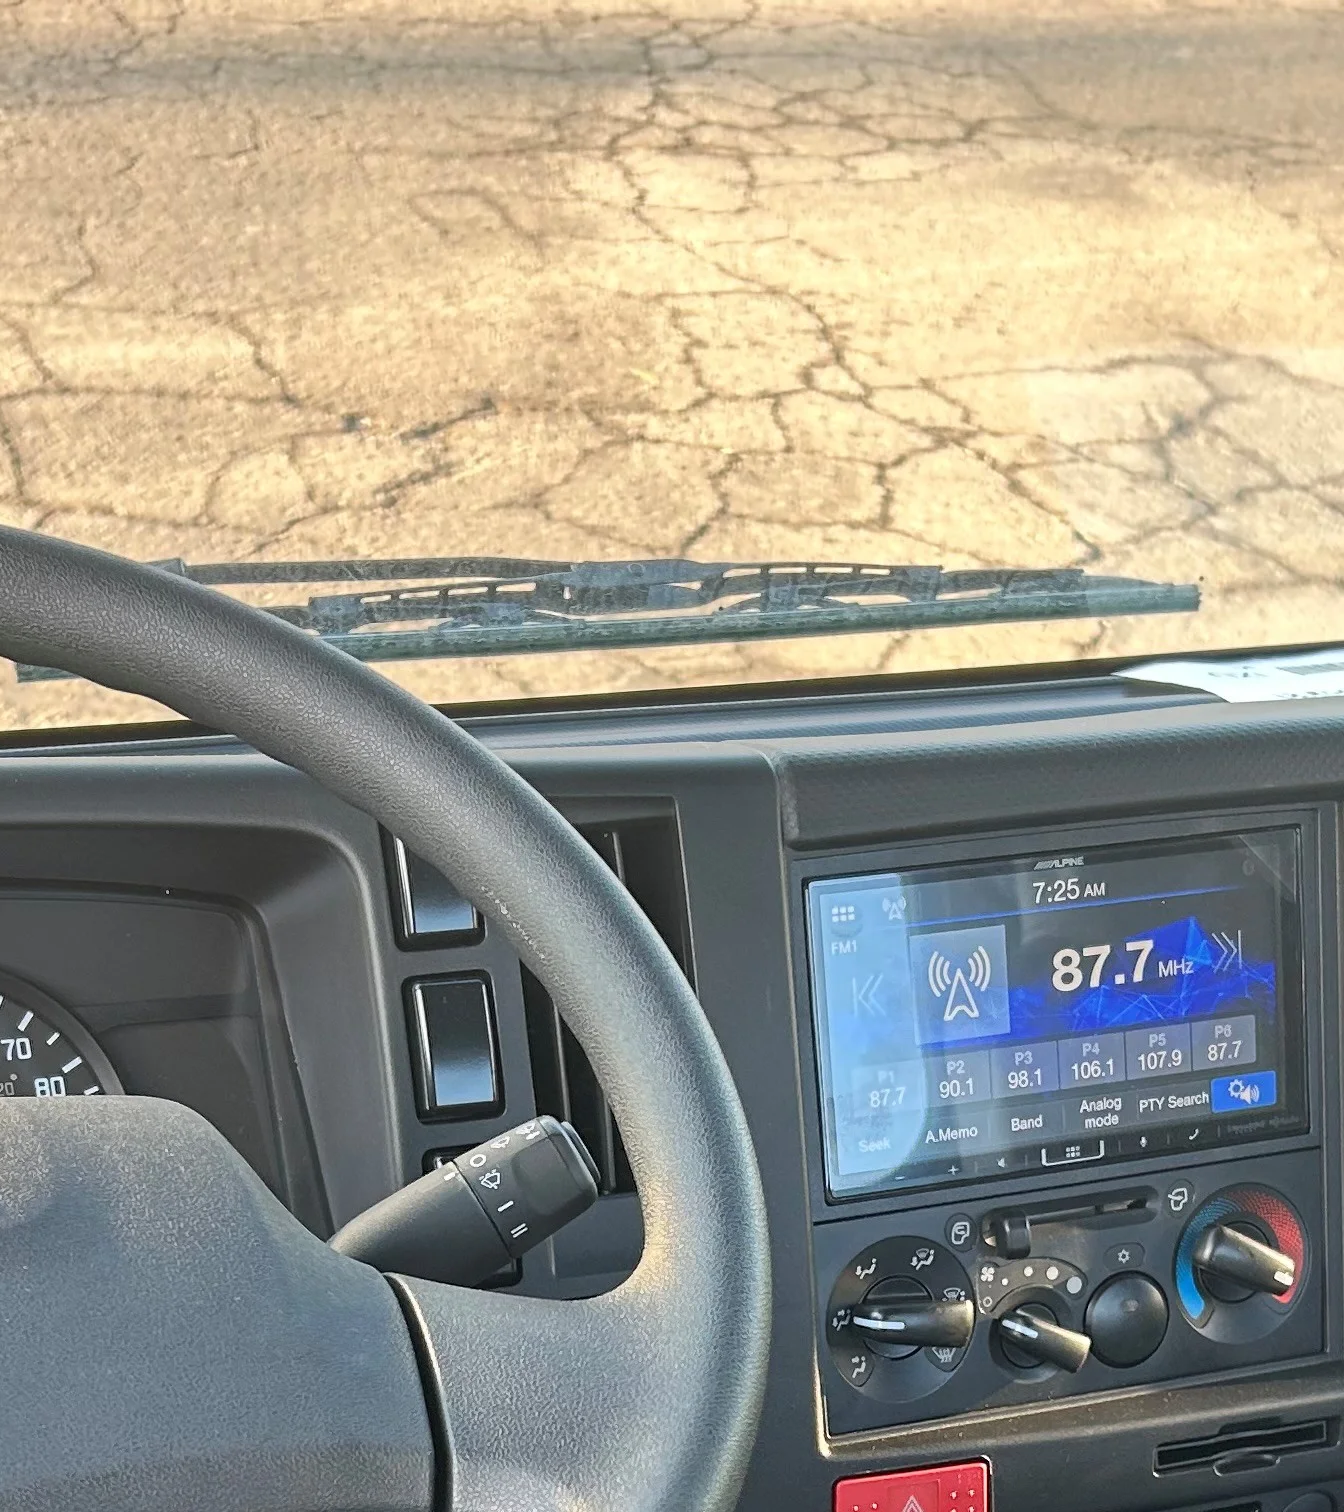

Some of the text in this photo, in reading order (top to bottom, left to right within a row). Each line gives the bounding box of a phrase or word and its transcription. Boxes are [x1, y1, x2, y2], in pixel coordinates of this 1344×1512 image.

[1033, 878, 1105, 904] 7:25 AM
[831, 941, 858, 955] FM1
[1052, 939, 1194, 992] 87.7 MHz
[1149, 1033, 1166, 1048] P5
[1214, 1024, 1232, 1039] P6
[0, 1037, 32, 1061] 70
[1015, 1051, 1033, 1066] P3
[1082, 1043, 1100, 1057] P4
[1208, 1040, 1242, 1062] 87.7
[947, 1060, 965, 1076] P2
[1071, 1058, 1114, 1081] 106.1
[1137, 1050, 1182, 1071] 107.9
[34, 1076, 66, 1097] 80
[1008, 1068, 1042, 1089] 98.1
[869, 1087, 906, 1108] 87.7
[939, 1078, 974, 1099] 90.1
[1079, 1096, 1122, 1113] Analog
[1139, 1092, 1209, 1113] PTY Search
[1011, 1115, 1043, 1131] Band
[1085, 1113, 1119, 1129] mode
[859, 1137, 890, 1152] Seek
[925, 1126, 978, 1144] A.Memo
